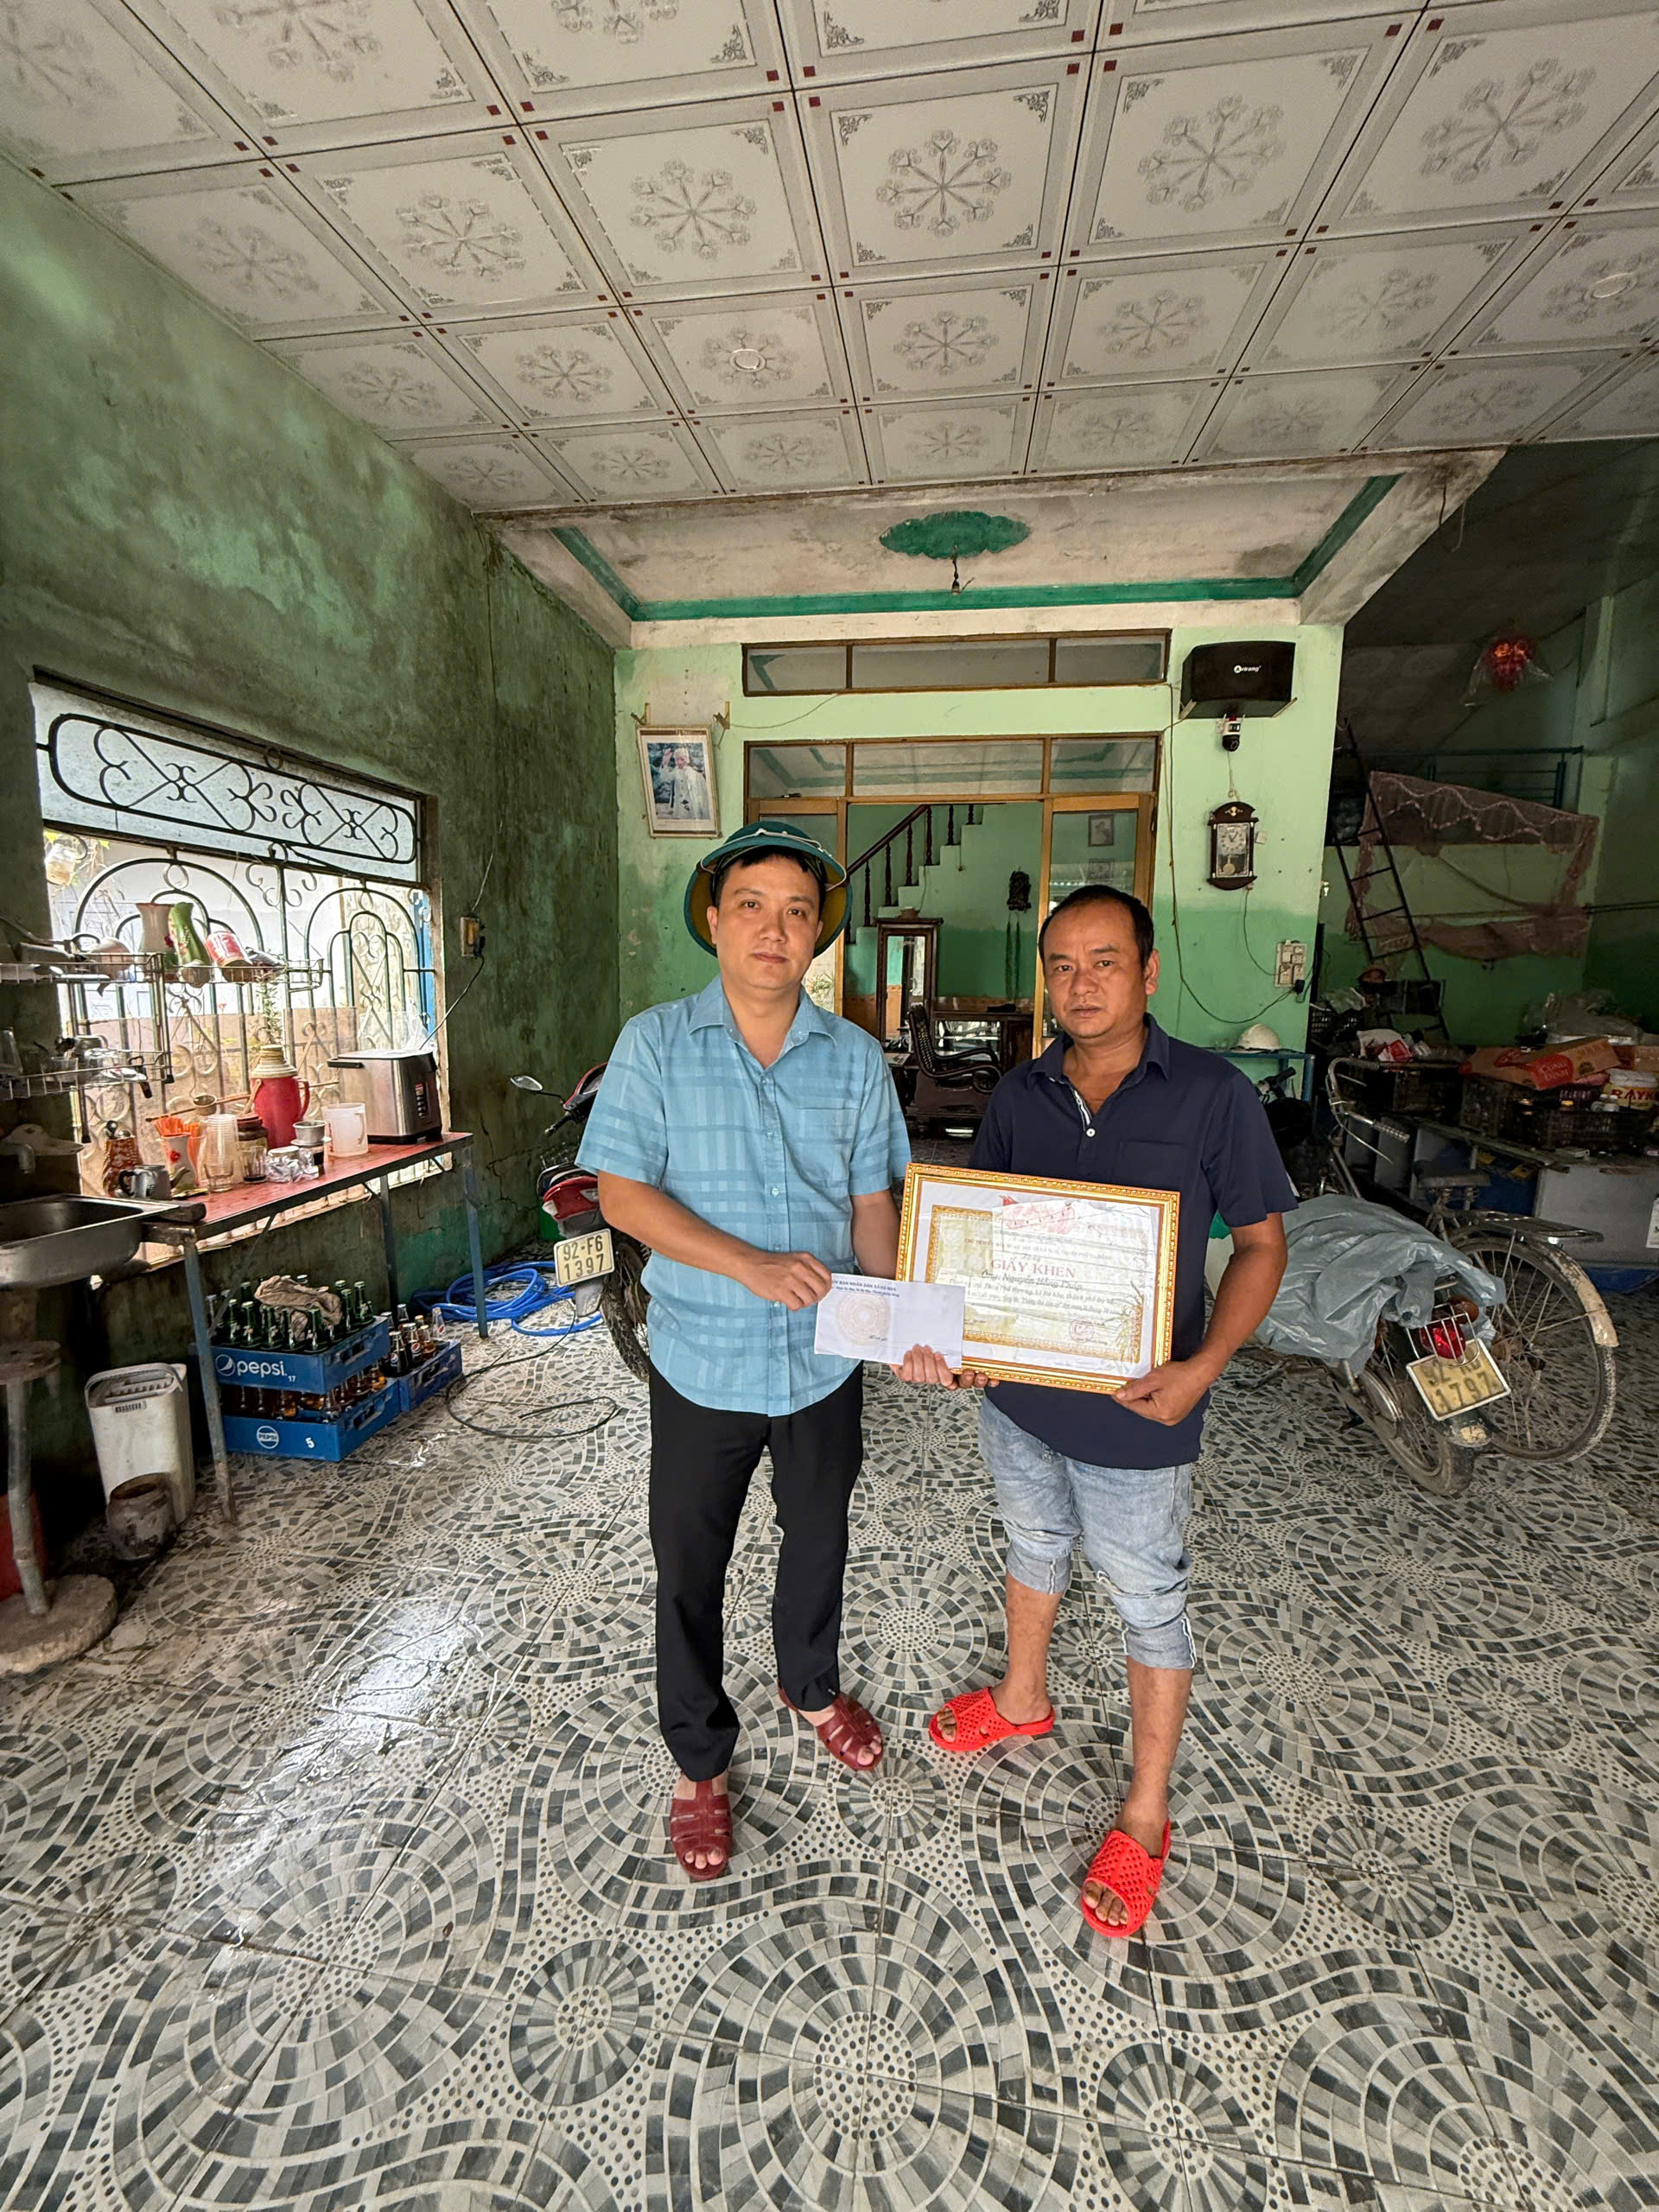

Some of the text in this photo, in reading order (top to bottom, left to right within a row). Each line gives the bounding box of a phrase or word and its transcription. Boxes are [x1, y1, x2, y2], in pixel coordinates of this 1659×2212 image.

[563, 1235, 603, 1261] 92-F6
[564, 1253, 604, 1280] 1397
[991, 1256, 1076, 1279] GIẤY KHEN
[237, 1360, 285, 1378] pepsi
[1436, 1371, 1493, 1411] 1797
[305, 1437, 315, 1449] 5
